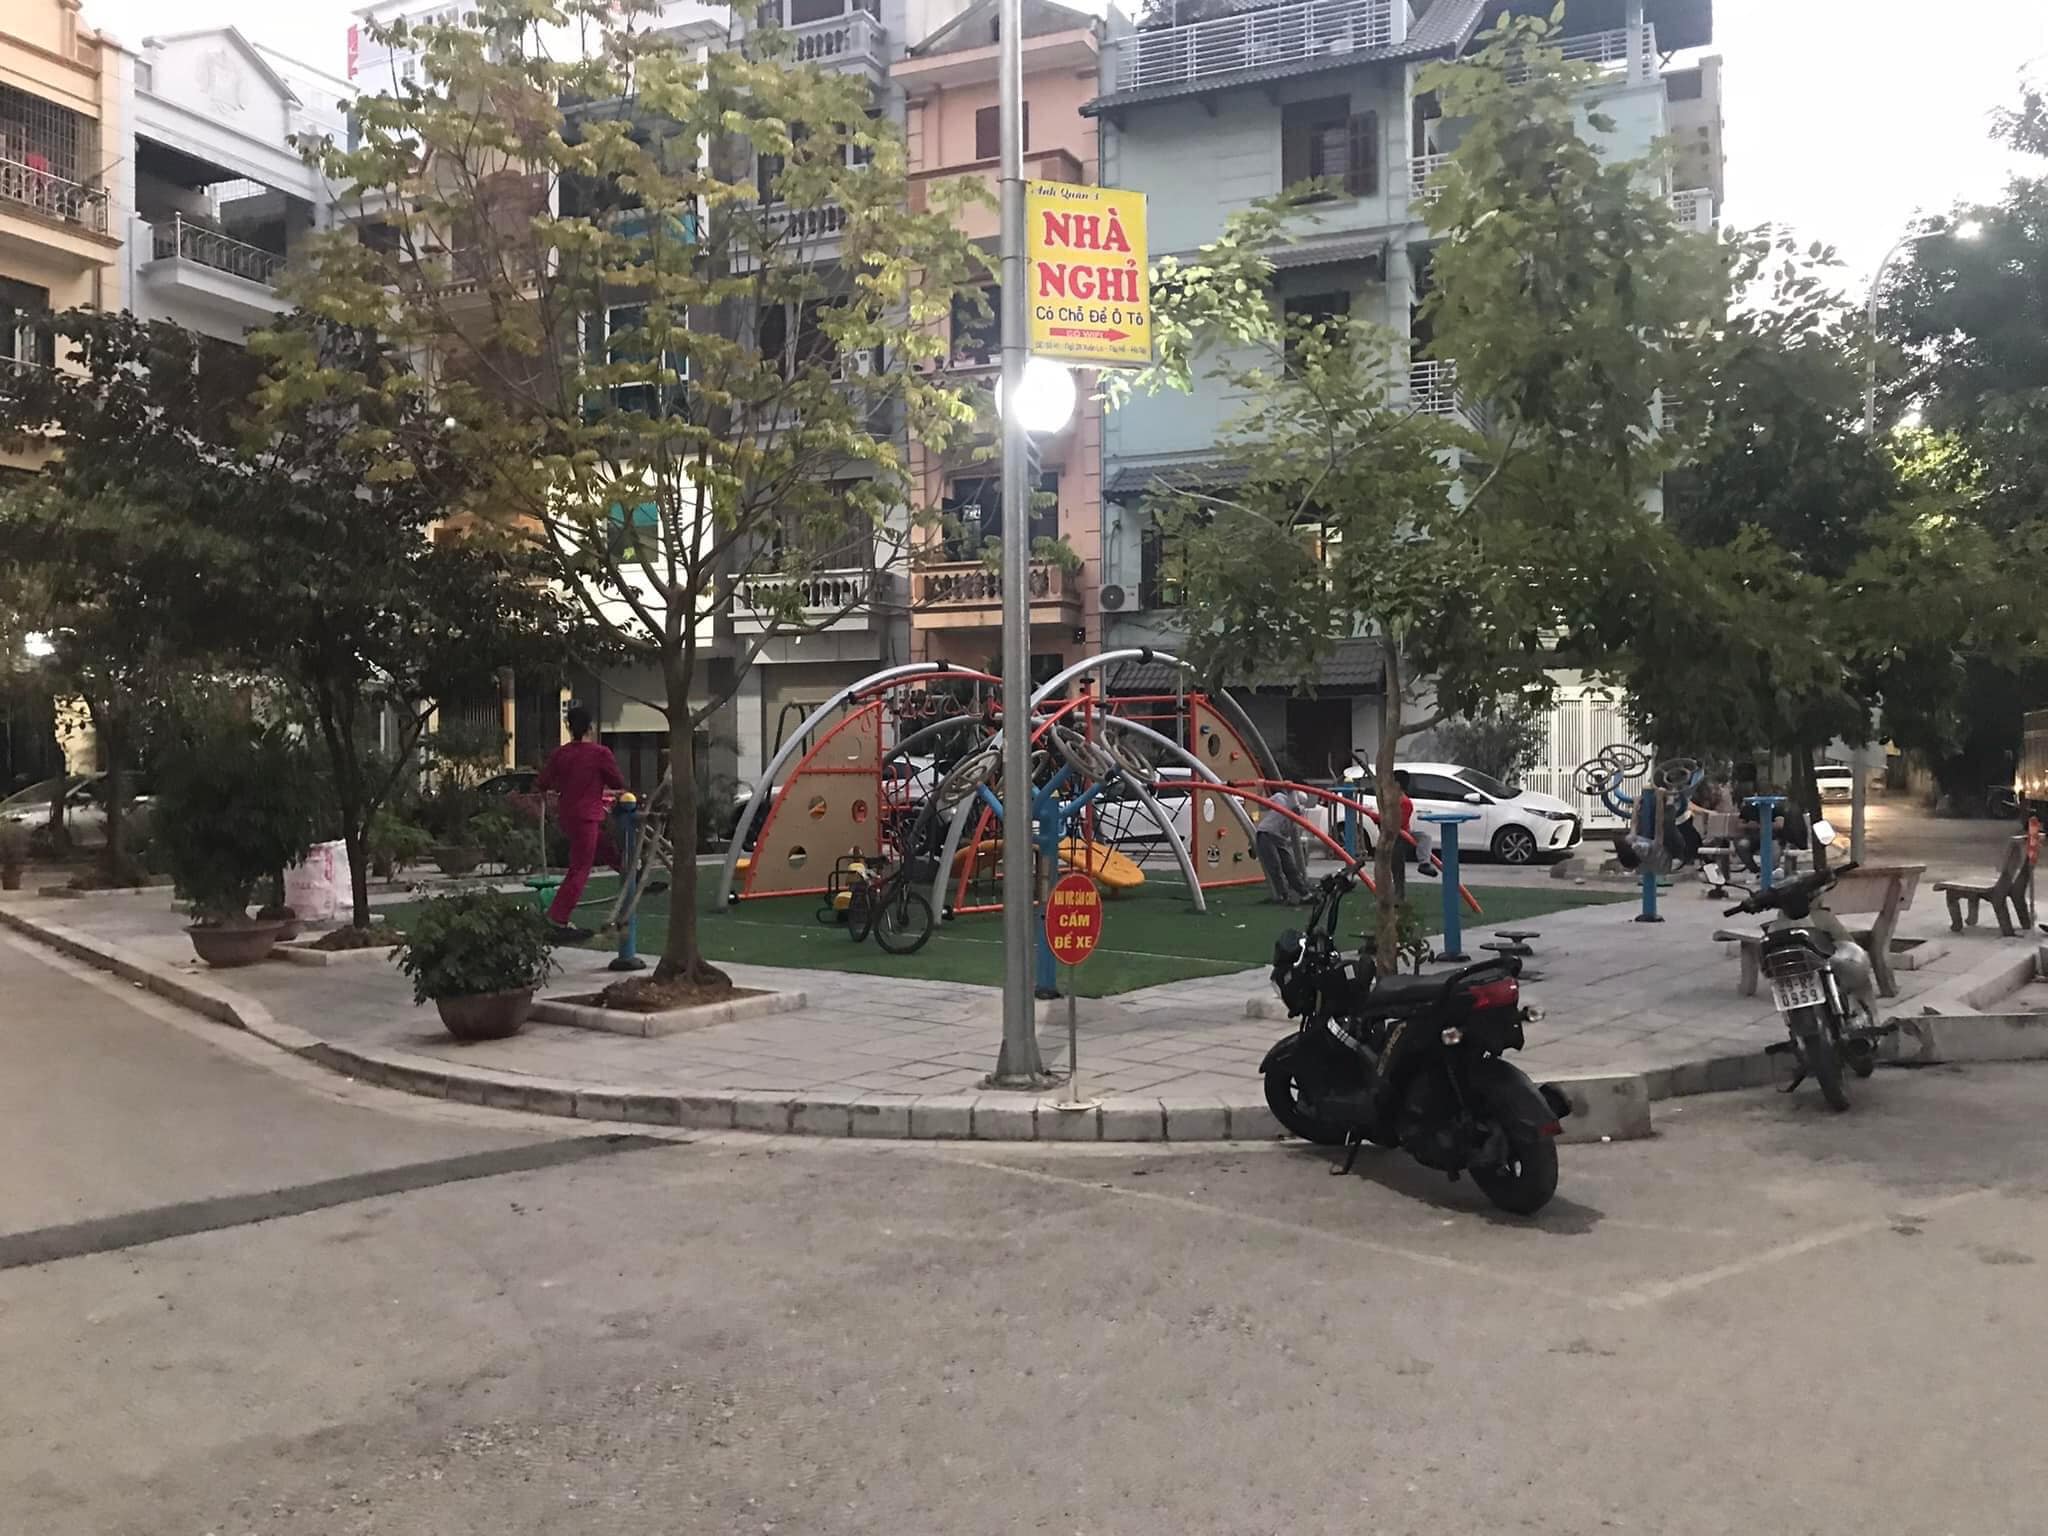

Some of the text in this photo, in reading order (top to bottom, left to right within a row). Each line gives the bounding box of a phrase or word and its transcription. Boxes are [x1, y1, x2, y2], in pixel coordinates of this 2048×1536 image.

[1042, 207, 1131, 252] NHÀ
[1037, 259, 1140, 303] NGHỈ
[1036, 305, 1144, 326] Có Chỗ Để Ô Tô
[1059, 909, 1090, 927] CẤM
[1076, 935, 1093, 949] XE
